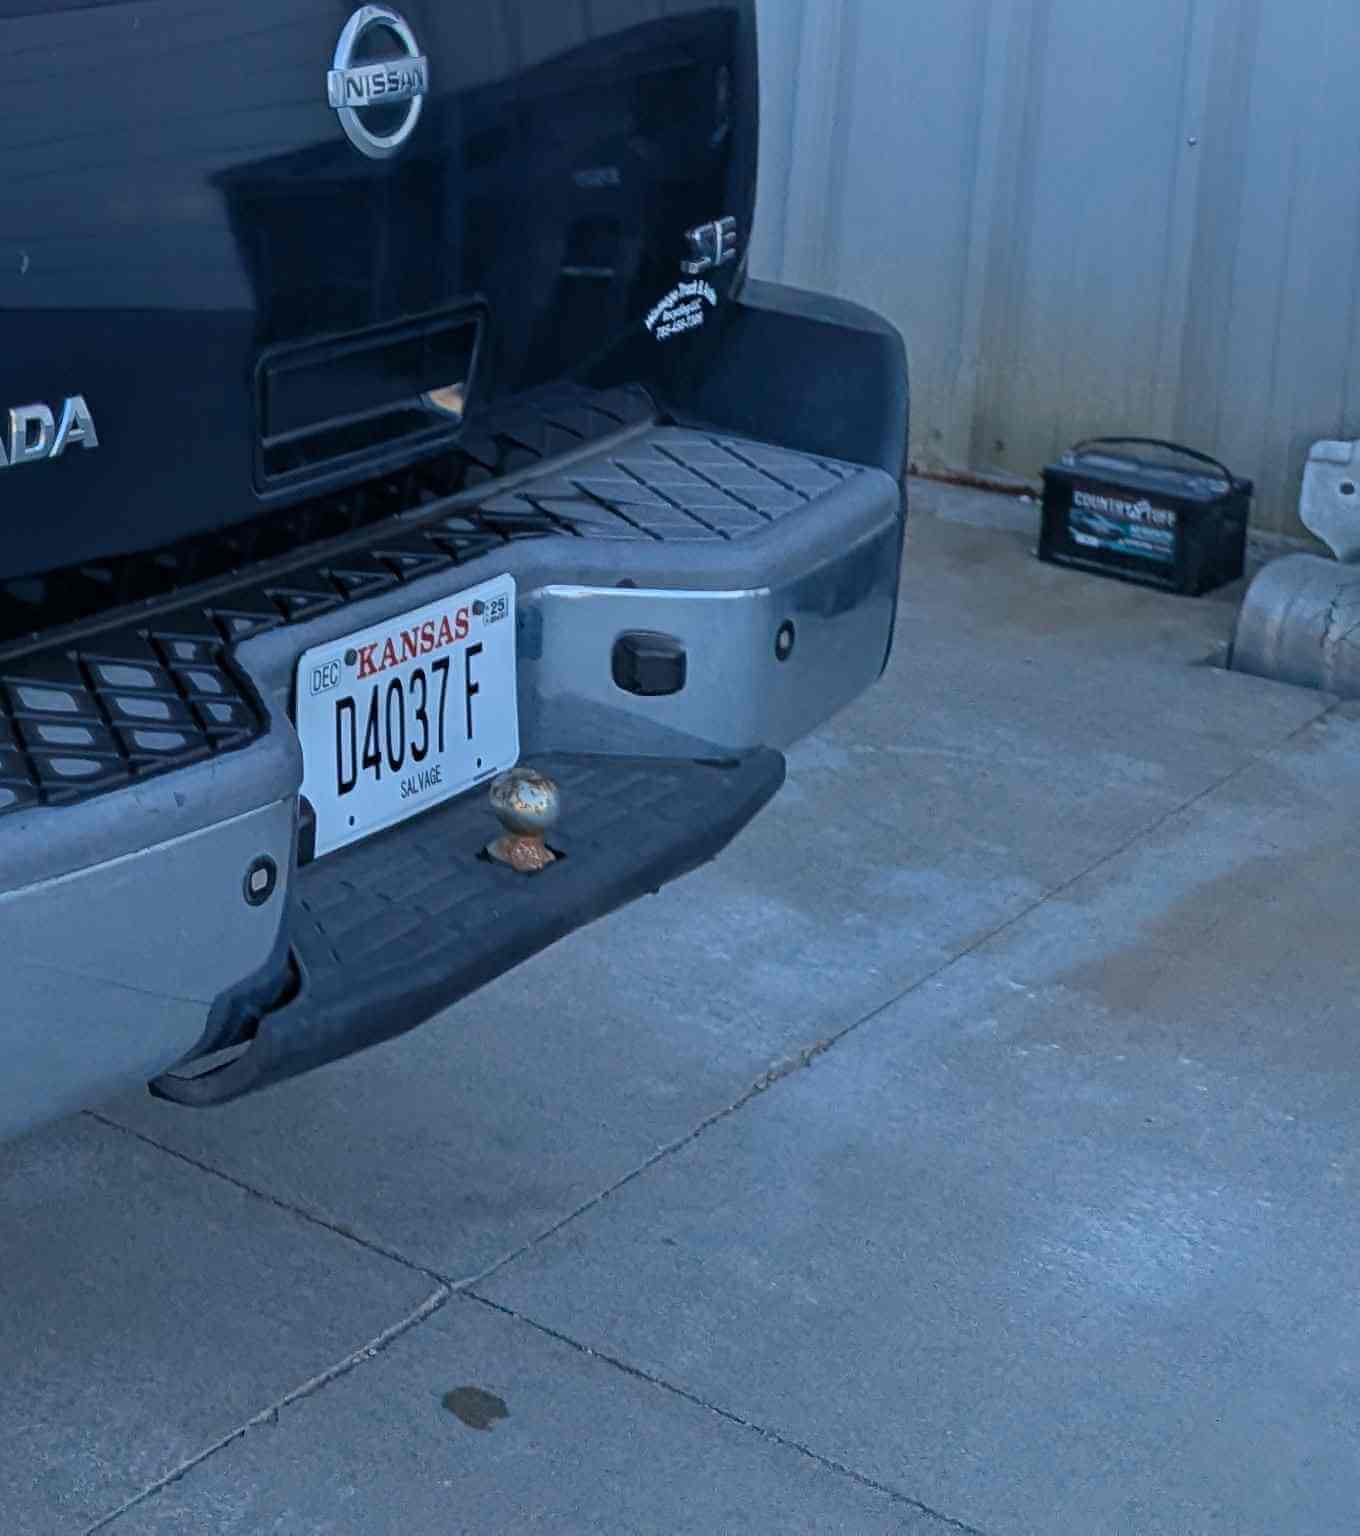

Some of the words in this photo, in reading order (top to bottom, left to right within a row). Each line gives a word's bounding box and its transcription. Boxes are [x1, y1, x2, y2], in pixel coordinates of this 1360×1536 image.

[346, 65, 424, 99] NISSAN
[681, 215, 736, 275] SE
[490, 597, 505, 615] 25
[313, 662, 338, 691] DEC
[356, 607, 470, 680] KANSAS
[400, 764, 443, 799] SALVAGE
